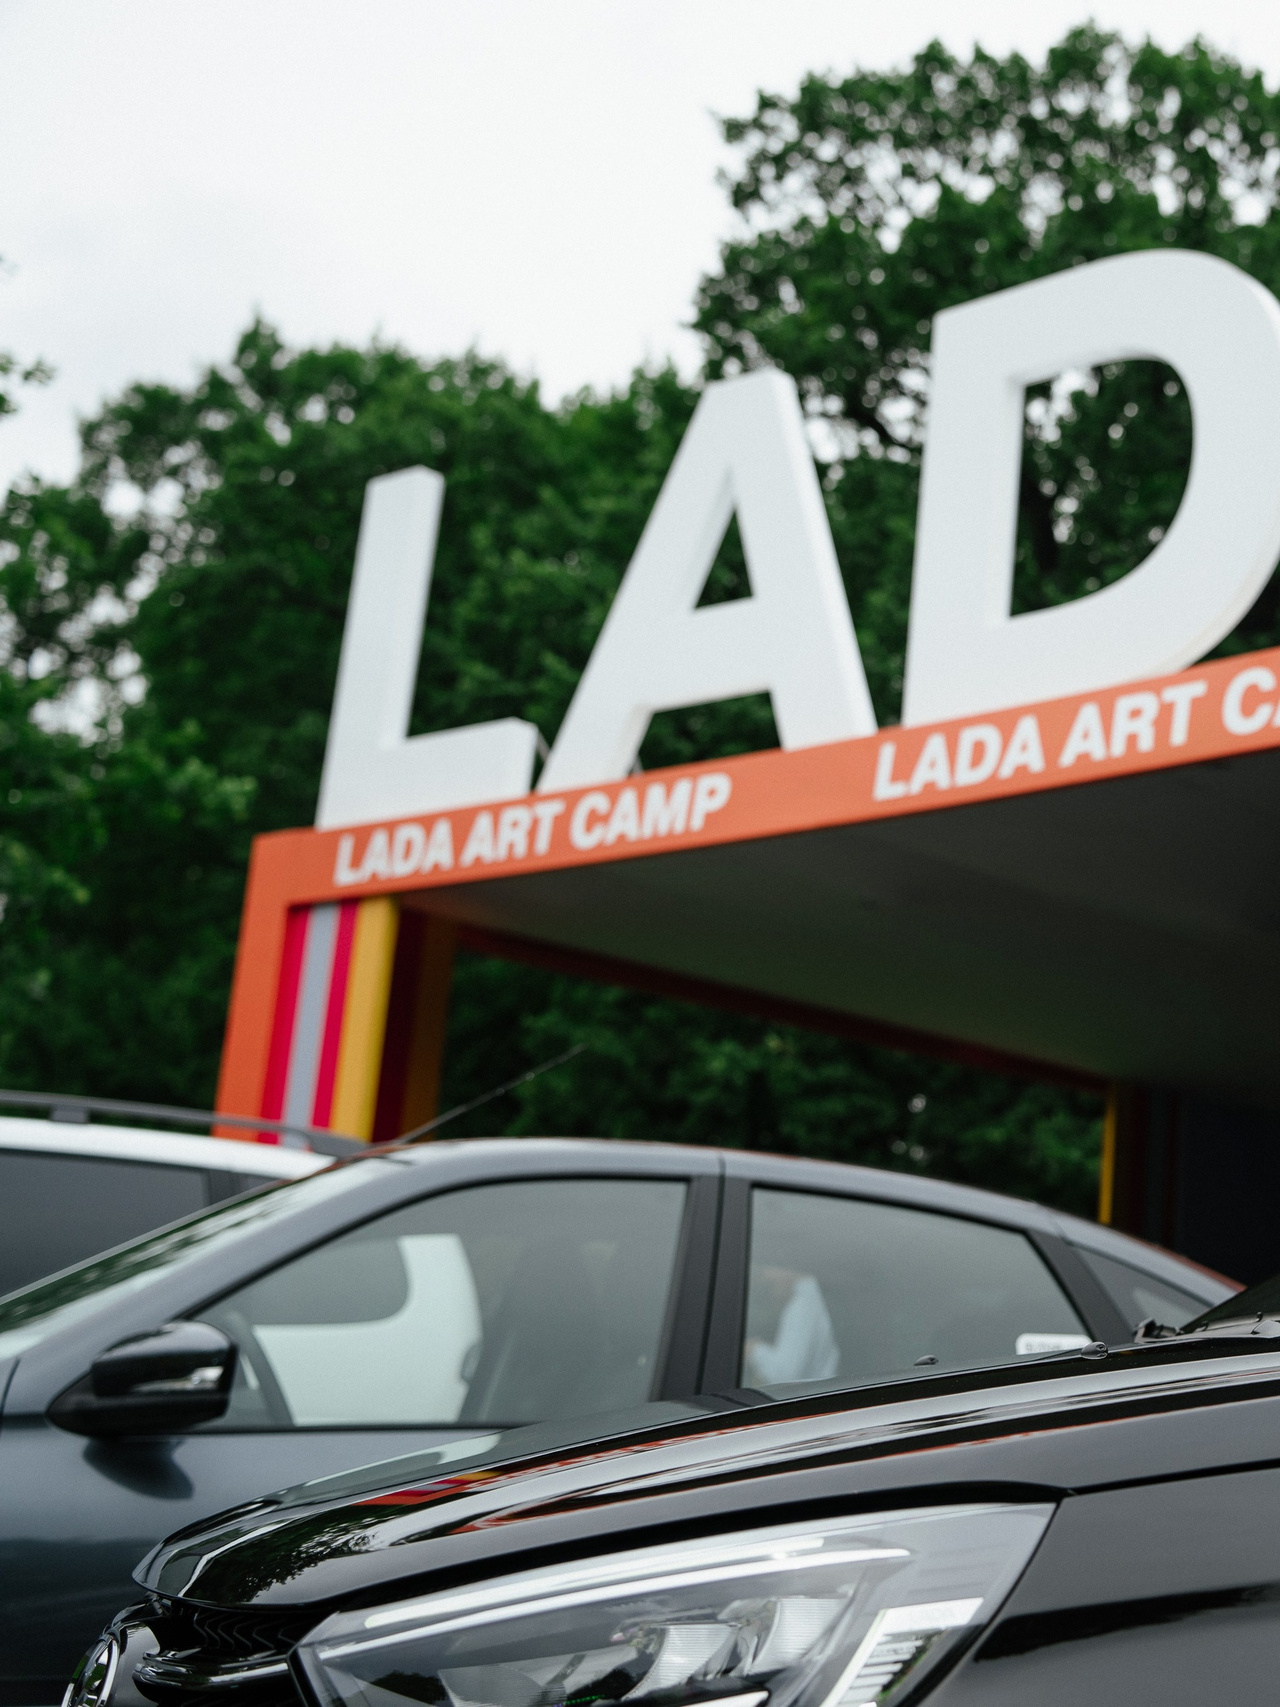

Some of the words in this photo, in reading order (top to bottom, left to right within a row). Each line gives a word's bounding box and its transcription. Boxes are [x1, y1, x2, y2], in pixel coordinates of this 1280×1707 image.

[872, 714, 1046, 802] LADA
[1057, 679, 1209, 768] ART
[334, 818, 455, 887] LADA
[460, 799, 566, 868] ART
[569, 772, 733, 851] CAMP
